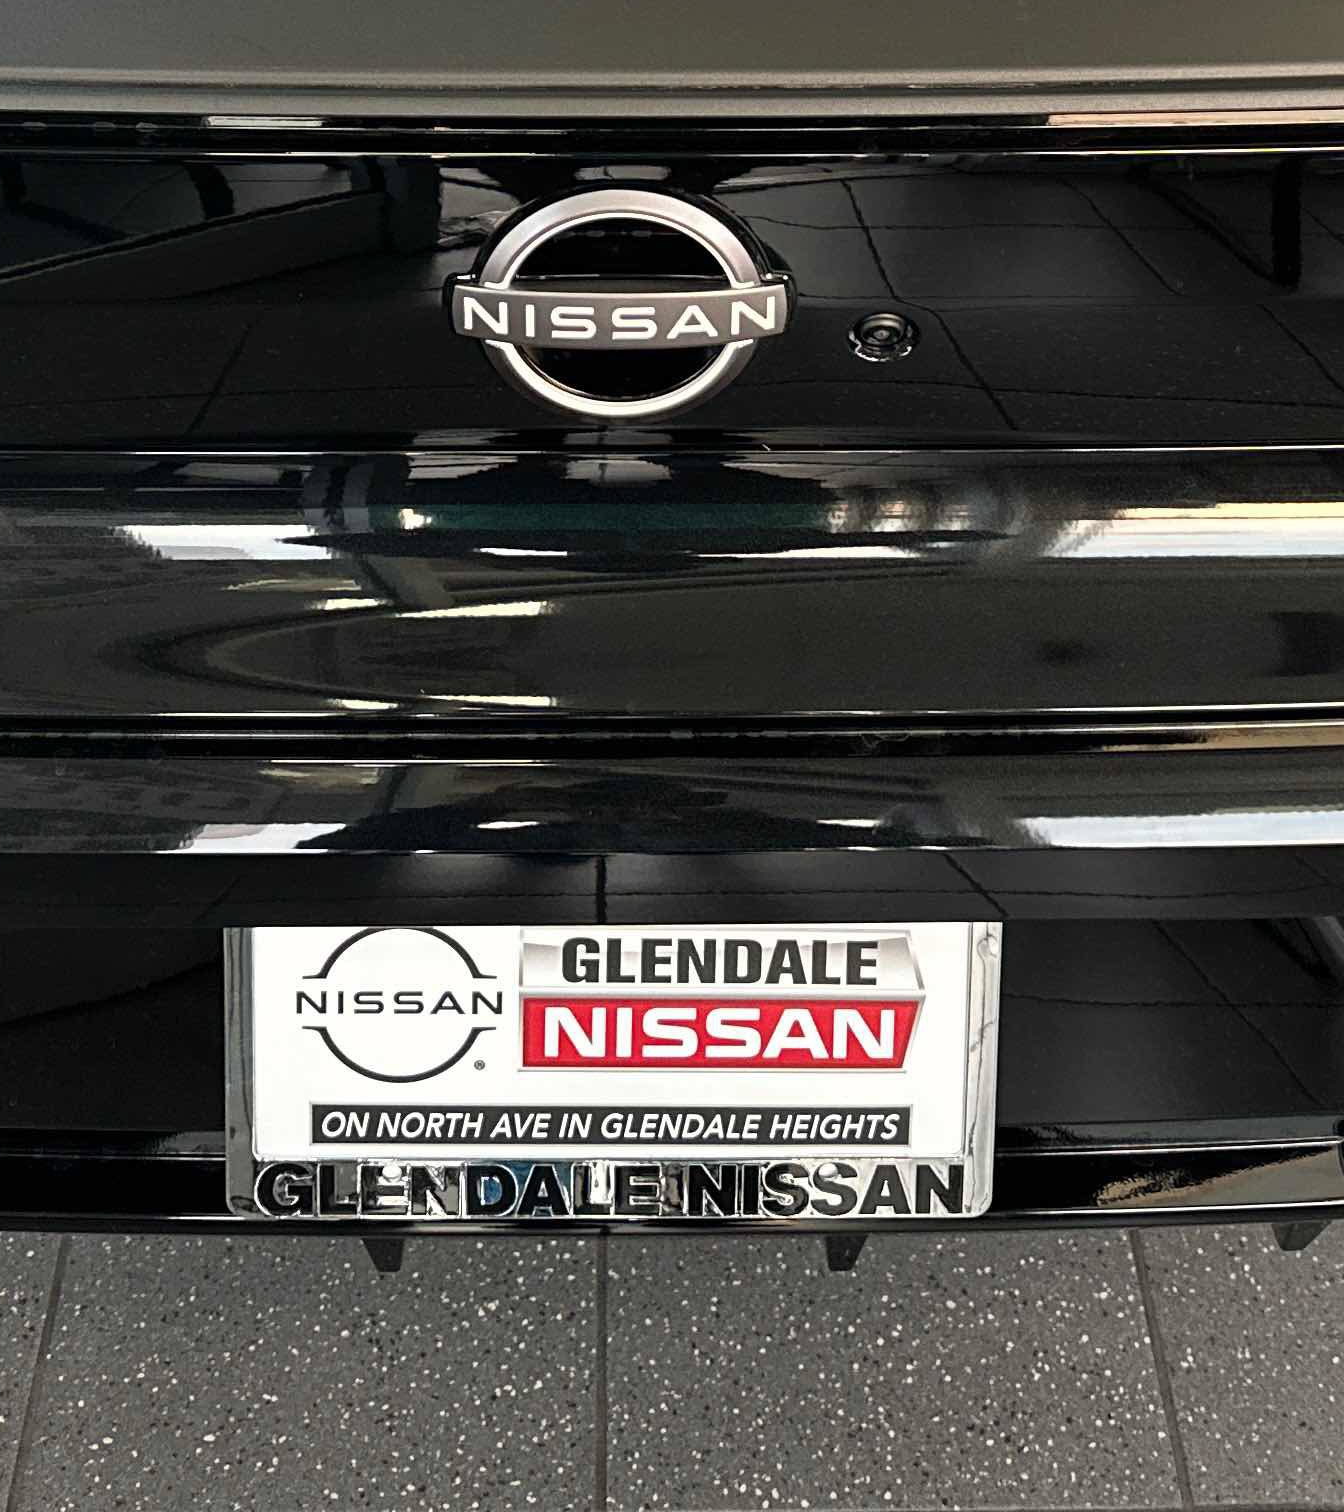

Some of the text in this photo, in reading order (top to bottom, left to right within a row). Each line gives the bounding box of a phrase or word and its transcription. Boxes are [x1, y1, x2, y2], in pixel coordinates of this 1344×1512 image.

[462, 296, 776, 341] NISSAN
[562, 936, 878, 986] GLENDALE
[295, 990, 504, 1016] NISSAN
[544, 1007, 896, 1060] NISSAN
[322, 1111, 901, 1140] ON NORTH AVE IN GLENDALE HEIGHTS
[256, 1162, 964, 1216] GLENDALE NISSAN
